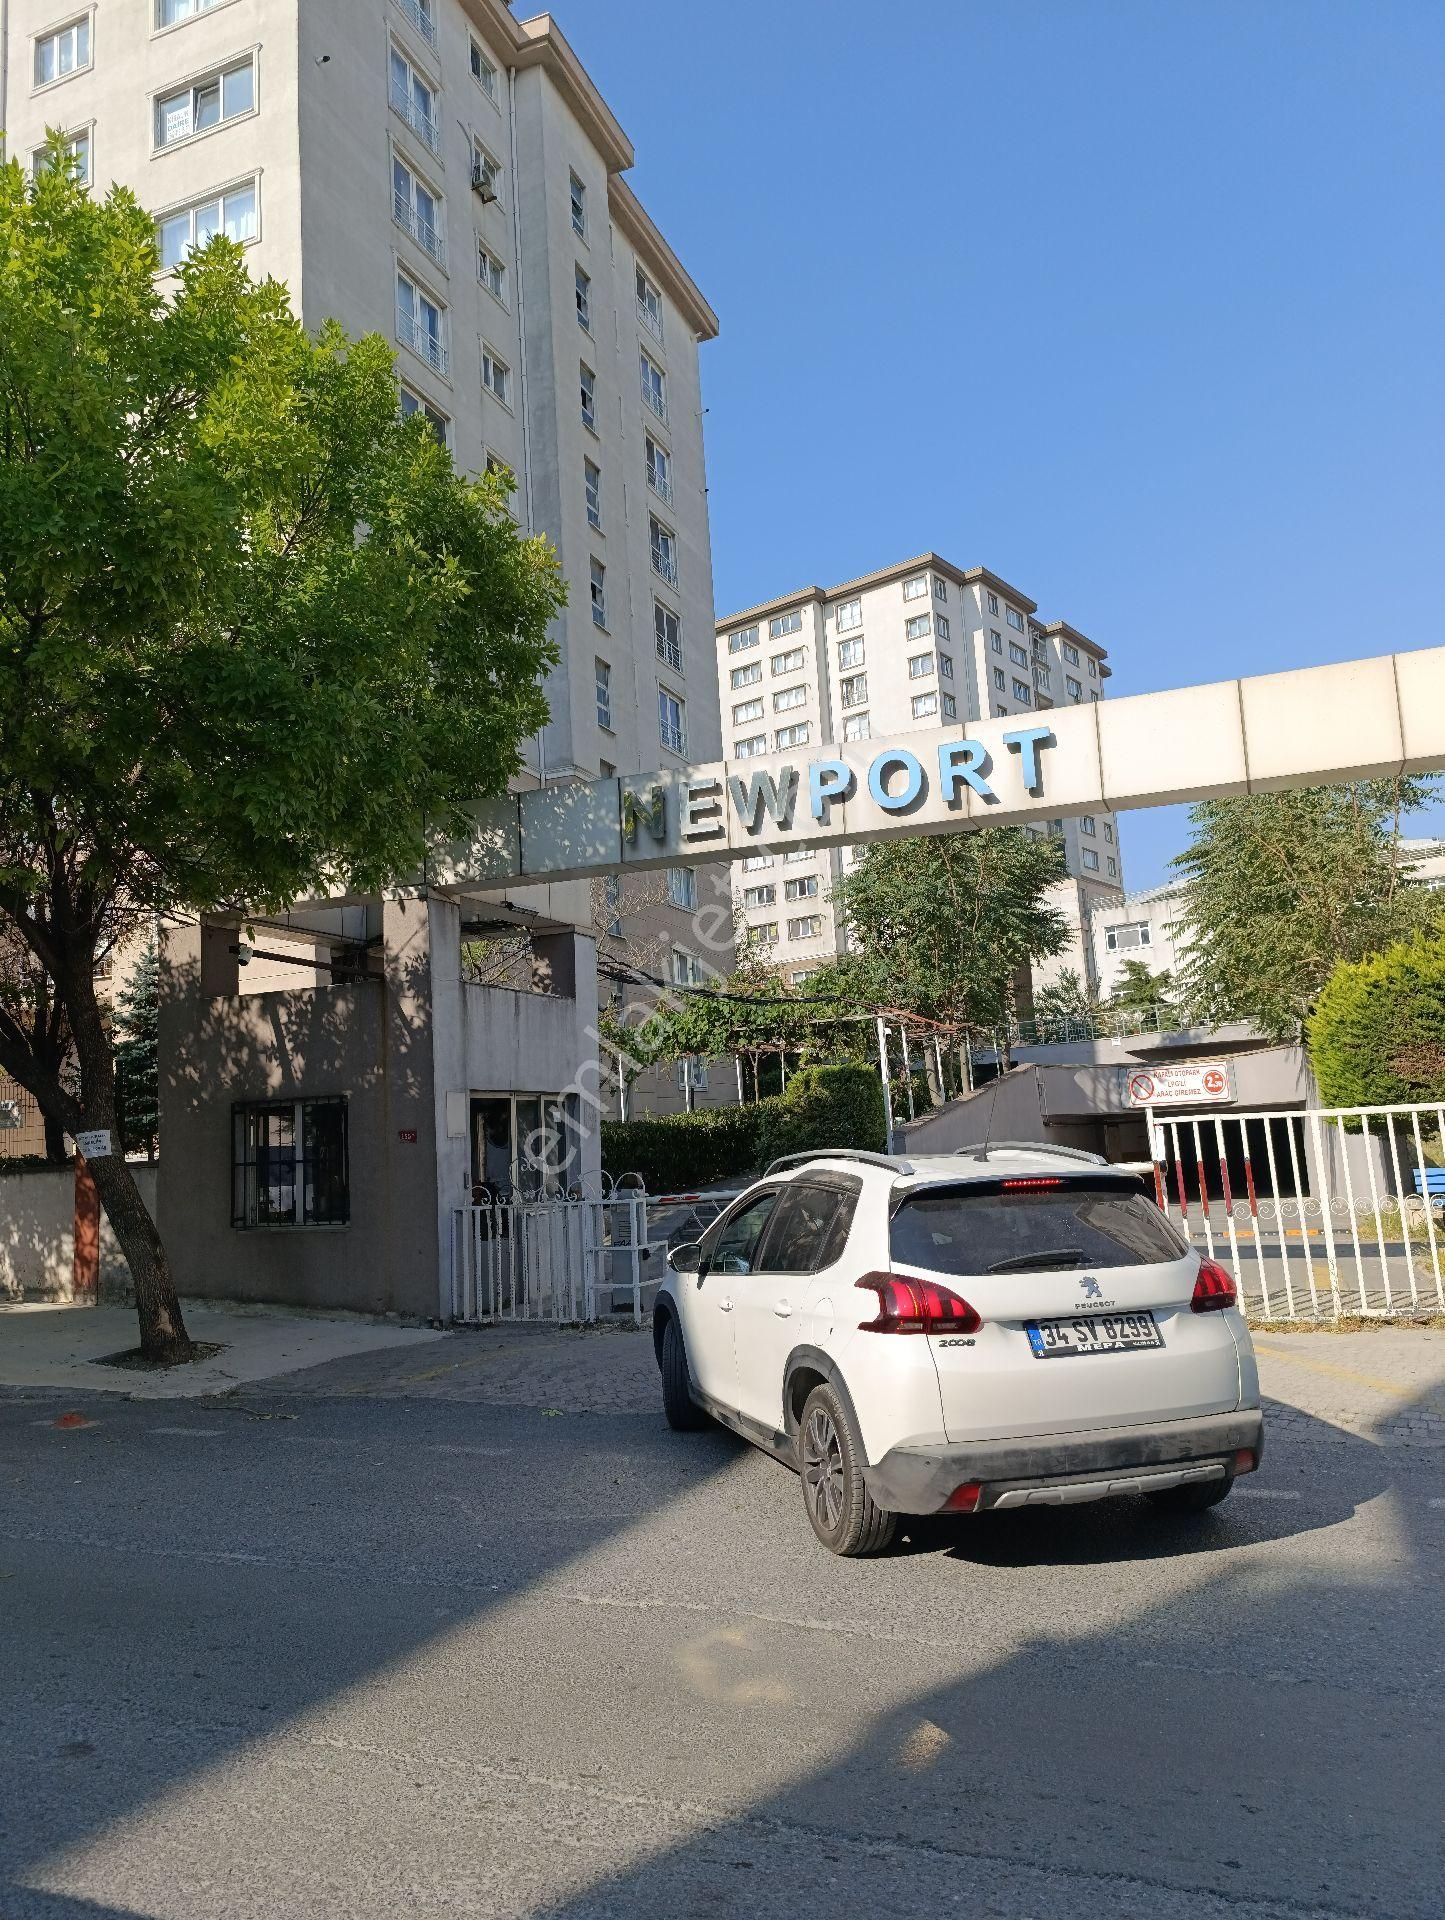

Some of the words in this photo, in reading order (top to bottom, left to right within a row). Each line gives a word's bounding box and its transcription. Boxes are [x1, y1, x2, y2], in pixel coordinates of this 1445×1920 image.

[624, 727, 1051, 842] NEWPORT
[1074, 1300, 1116, 1310] PEUGEOT
[1041, 1323, 1070, 1347] 34
[1072, 1319, 1099, 1343] SV
[1101, 1315, 1153, 1340] 8299
[939, 1338, 976, 1348] 2008
[1076, 1341, 1126, 1352] MEPA
